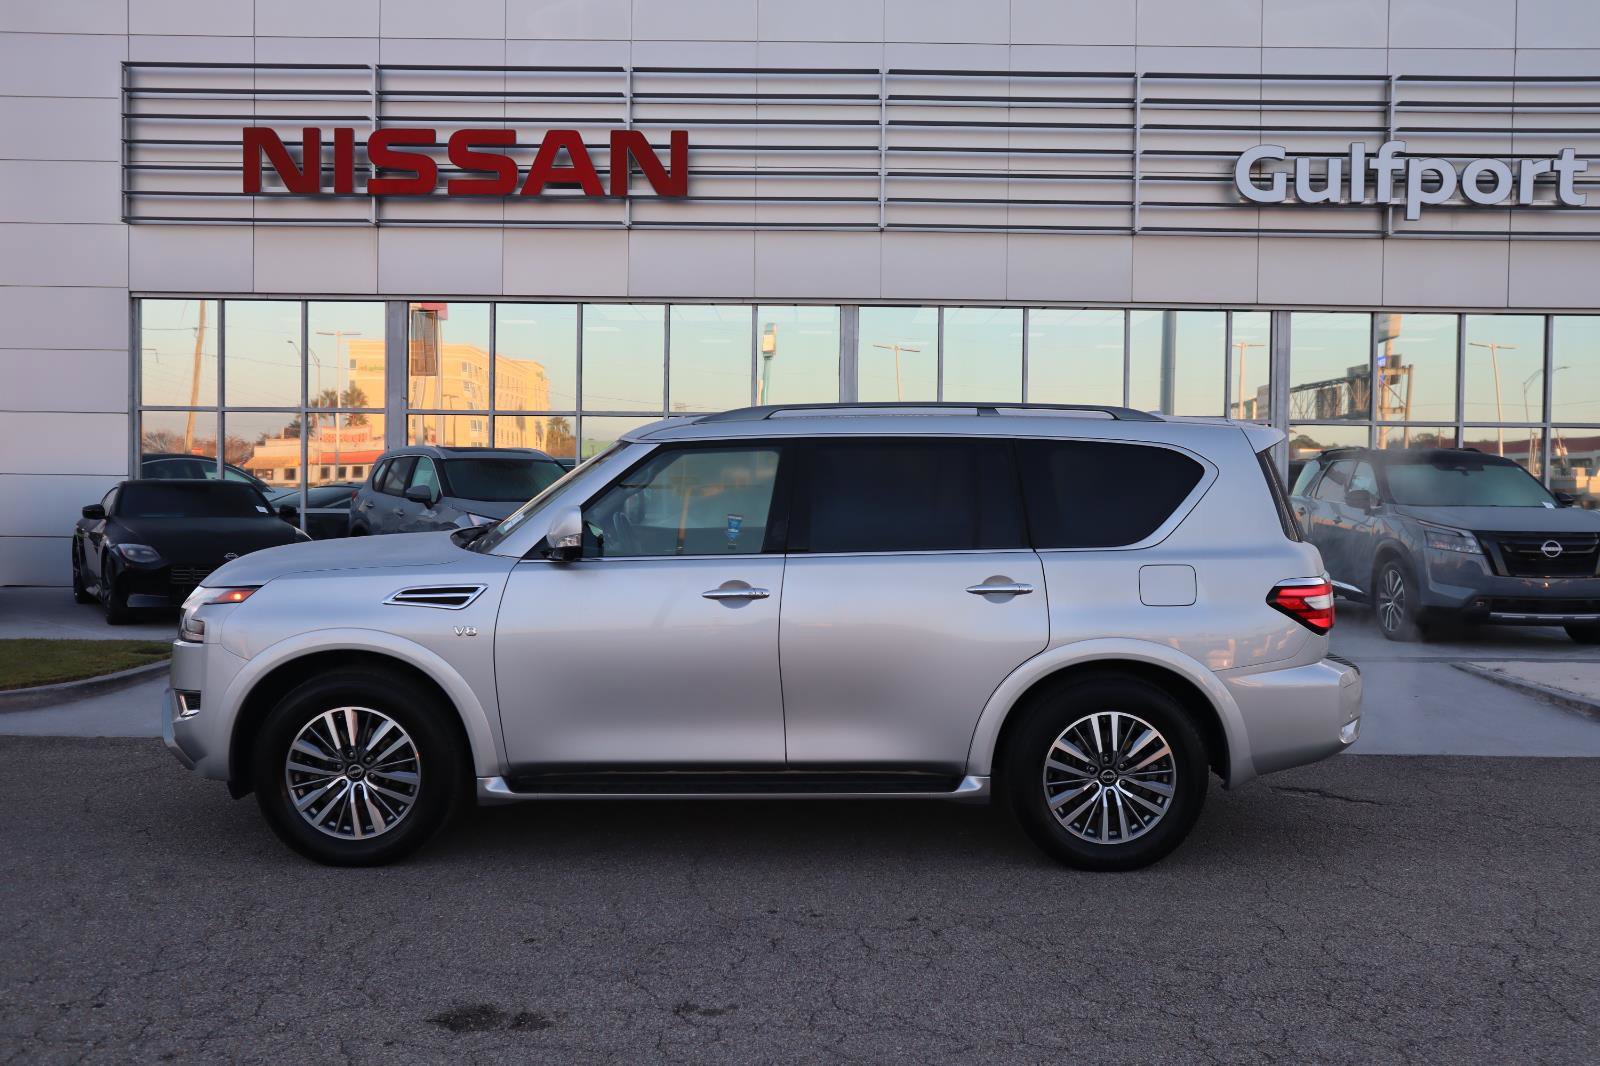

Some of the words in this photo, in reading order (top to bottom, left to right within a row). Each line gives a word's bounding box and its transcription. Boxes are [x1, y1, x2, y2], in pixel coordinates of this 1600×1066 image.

[243, 127, 689, 197] NISSAN
[1234, 140, 1588, 220] Gulfport
[454, 625, 478, 637] V8
